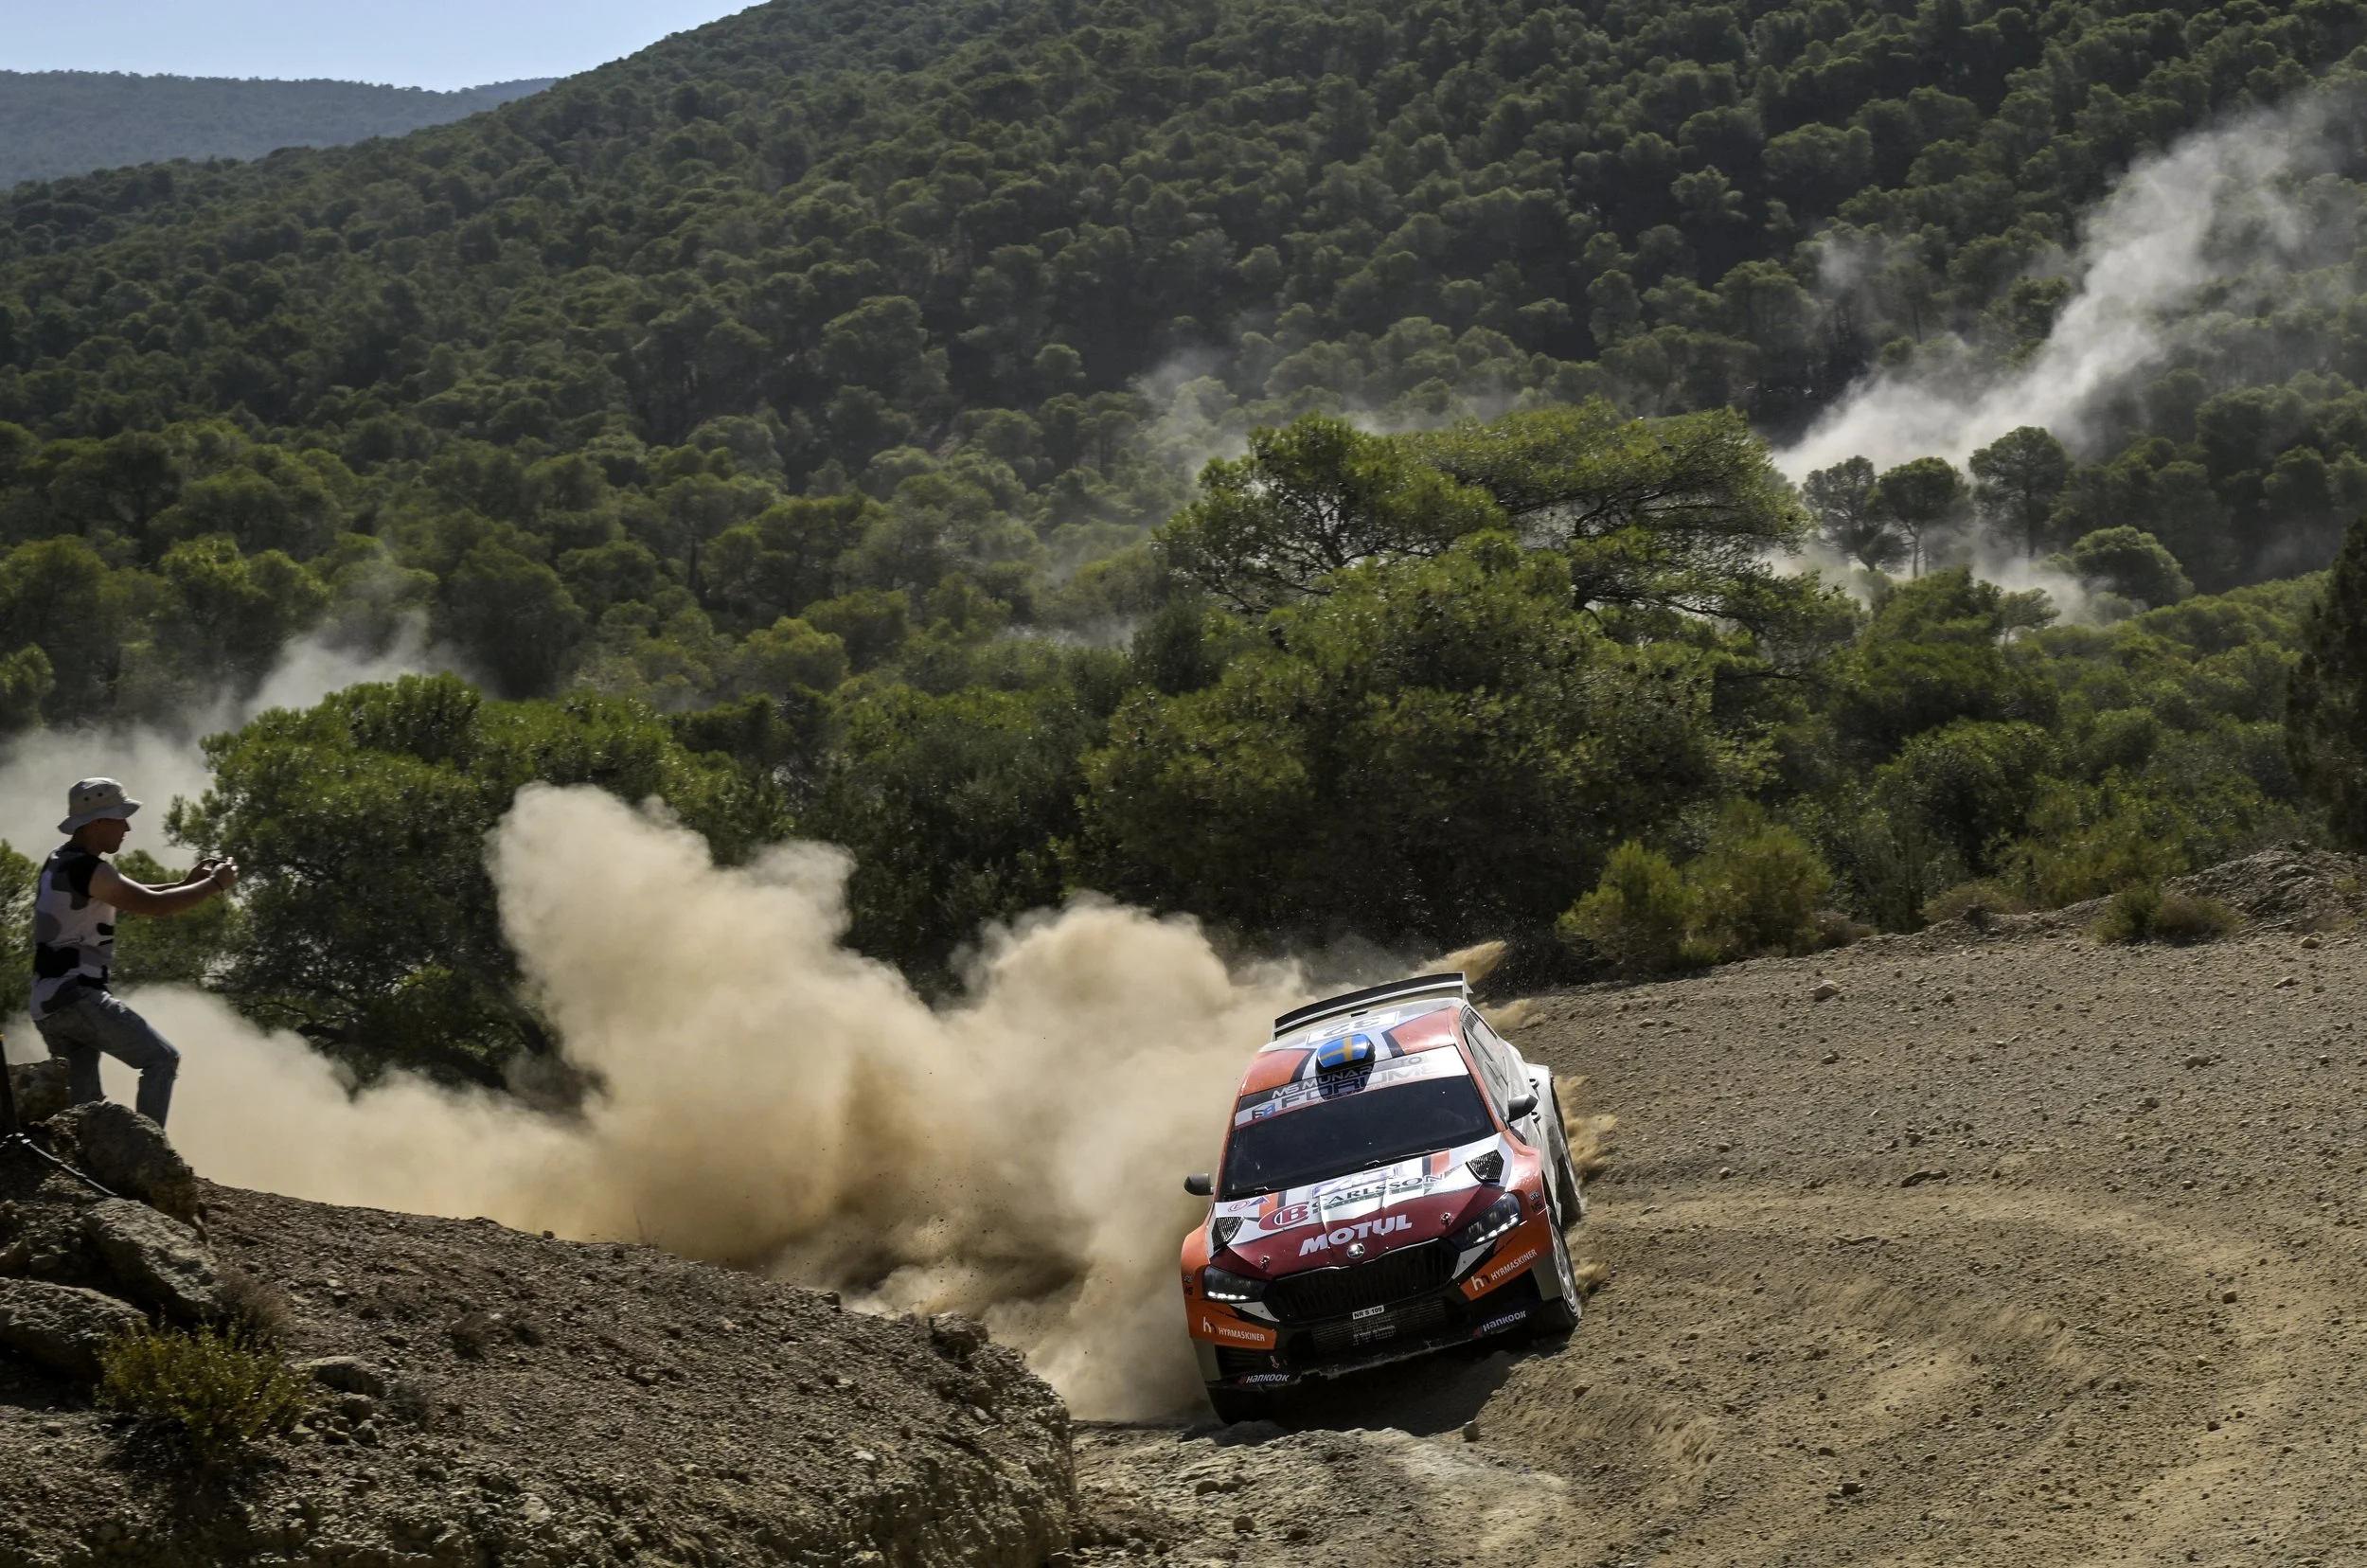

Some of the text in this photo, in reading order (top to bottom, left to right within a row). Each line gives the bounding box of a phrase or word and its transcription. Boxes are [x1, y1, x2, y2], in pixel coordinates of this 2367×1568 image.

[1272, 1084, 1298, 1099] MS
[1302, 1056, 1424, 1090] MUNARTO
[1311, 1171, 1445, 1208] CARLSSON
[1298, 1215, 1413, 1256] MOTUL
[1490, 1249, 1539, 1281] HYRMASKINER
[1219, 1327, 1266, 1342] HYRMASKINER
